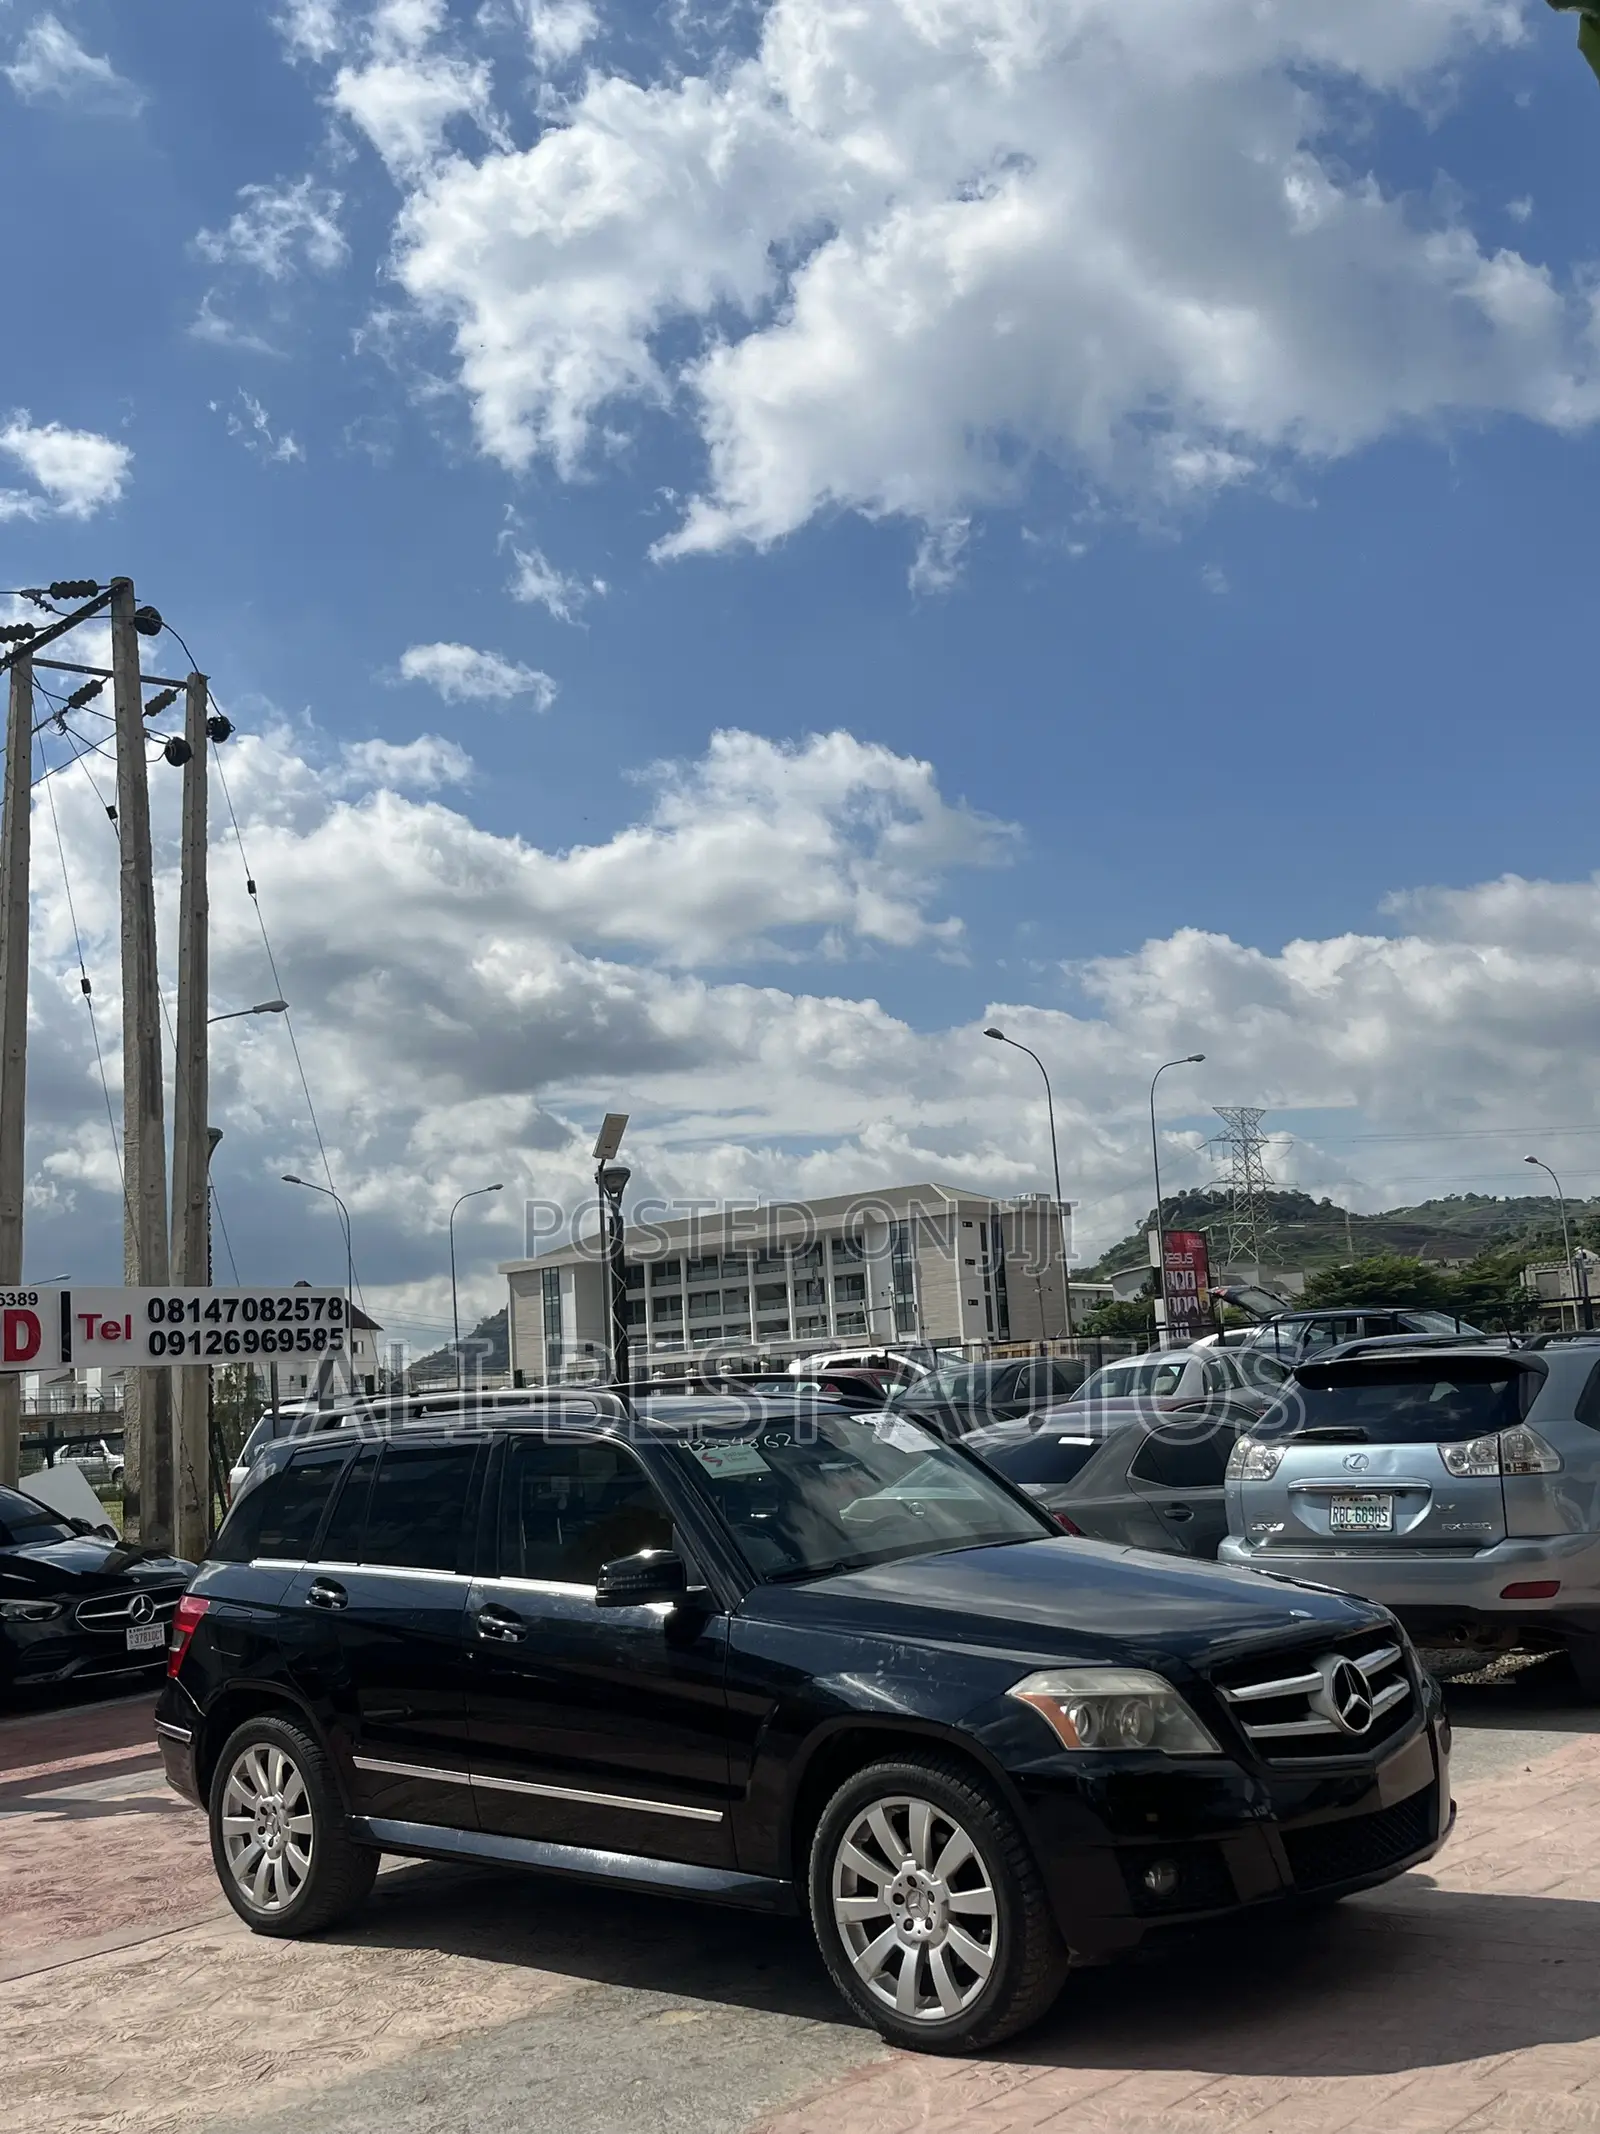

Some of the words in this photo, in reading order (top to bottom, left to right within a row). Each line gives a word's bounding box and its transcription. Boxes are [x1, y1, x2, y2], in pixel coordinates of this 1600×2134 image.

[3, 1309, 42, 1362] D
[77, 1313, 132, 1340] Tel
[147, 1297, 343, 1323] 08147082578
[149, 1328, 344, 1356] 09126969585
